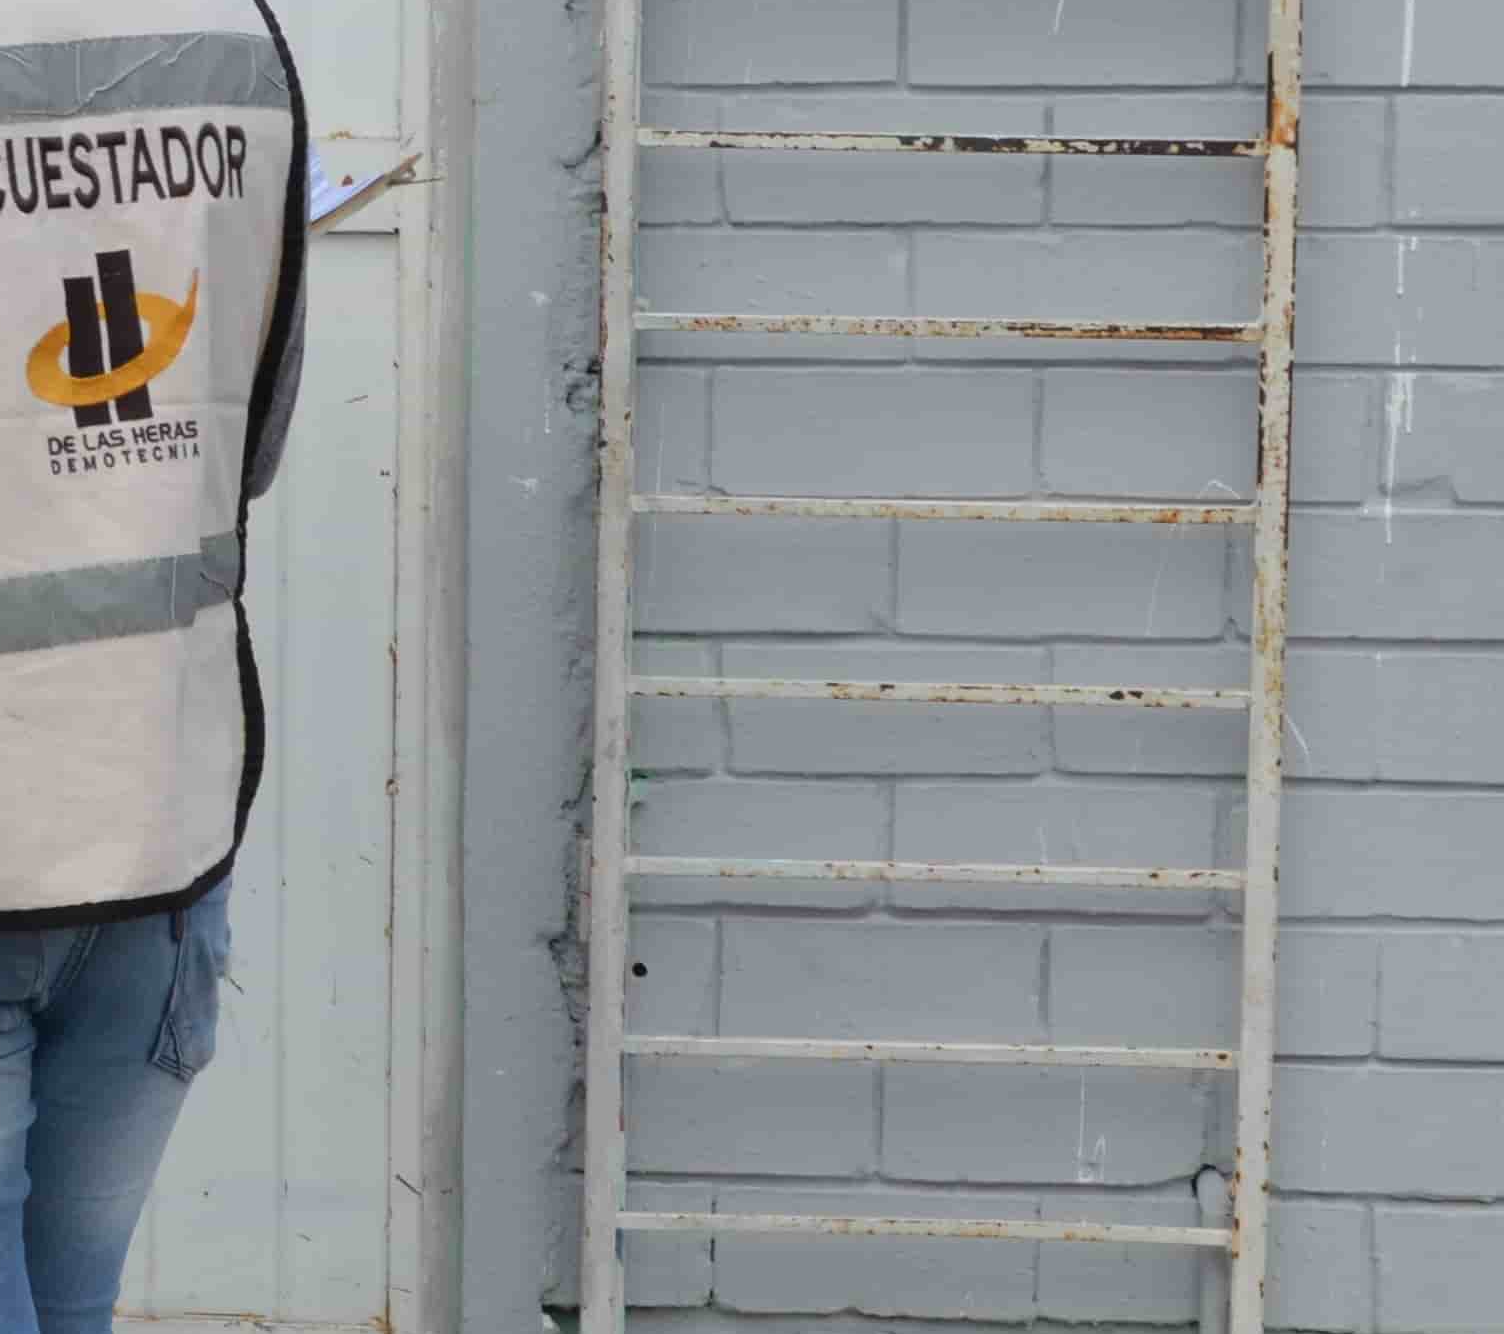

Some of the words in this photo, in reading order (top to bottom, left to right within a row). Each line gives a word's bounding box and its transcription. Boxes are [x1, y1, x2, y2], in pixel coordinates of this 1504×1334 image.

[48, 435, 76, 456] DE
[83, 429, 125, 451] LAS
[132, 420, 199, 444] HERAS
[50, 442, 201, 475] DEMOTECNIA
